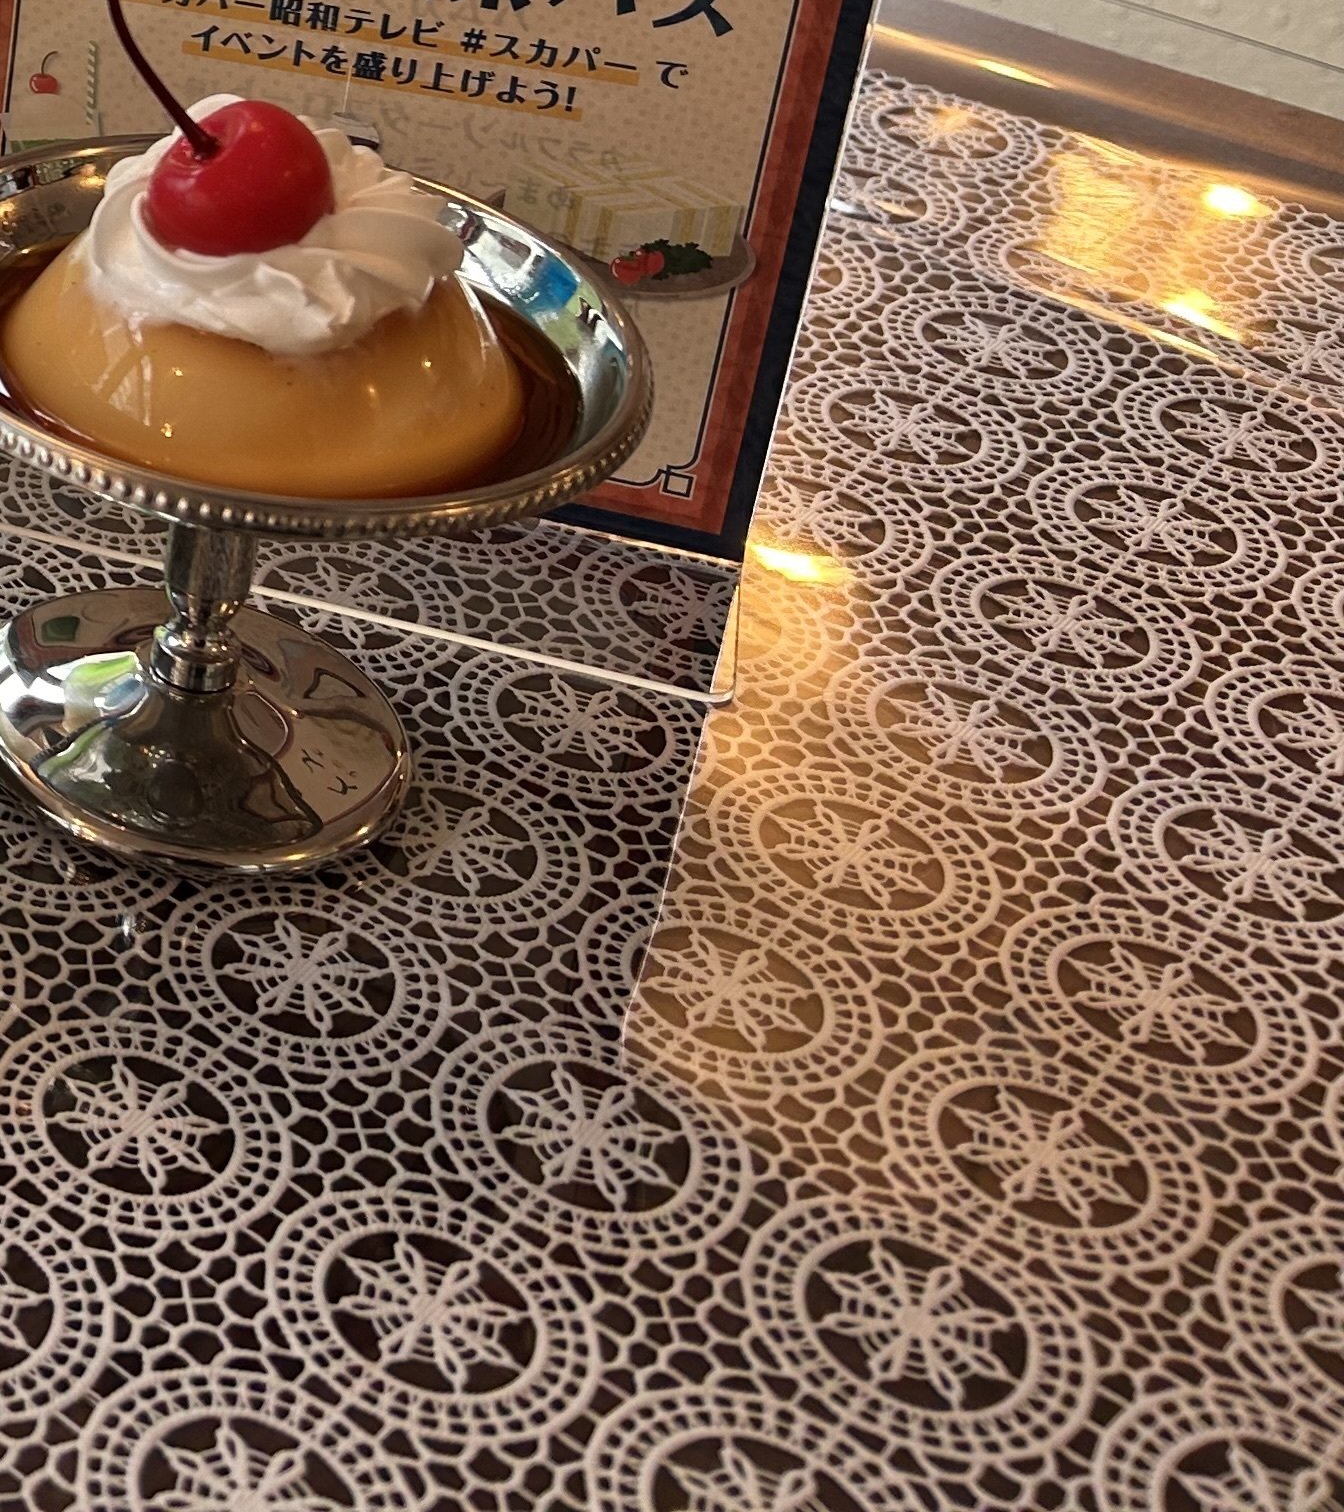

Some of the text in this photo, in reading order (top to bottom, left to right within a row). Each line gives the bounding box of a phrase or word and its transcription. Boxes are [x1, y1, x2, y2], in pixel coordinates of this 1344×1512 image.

[190, 24, 577, 113] イベントを盛り上げよう!
